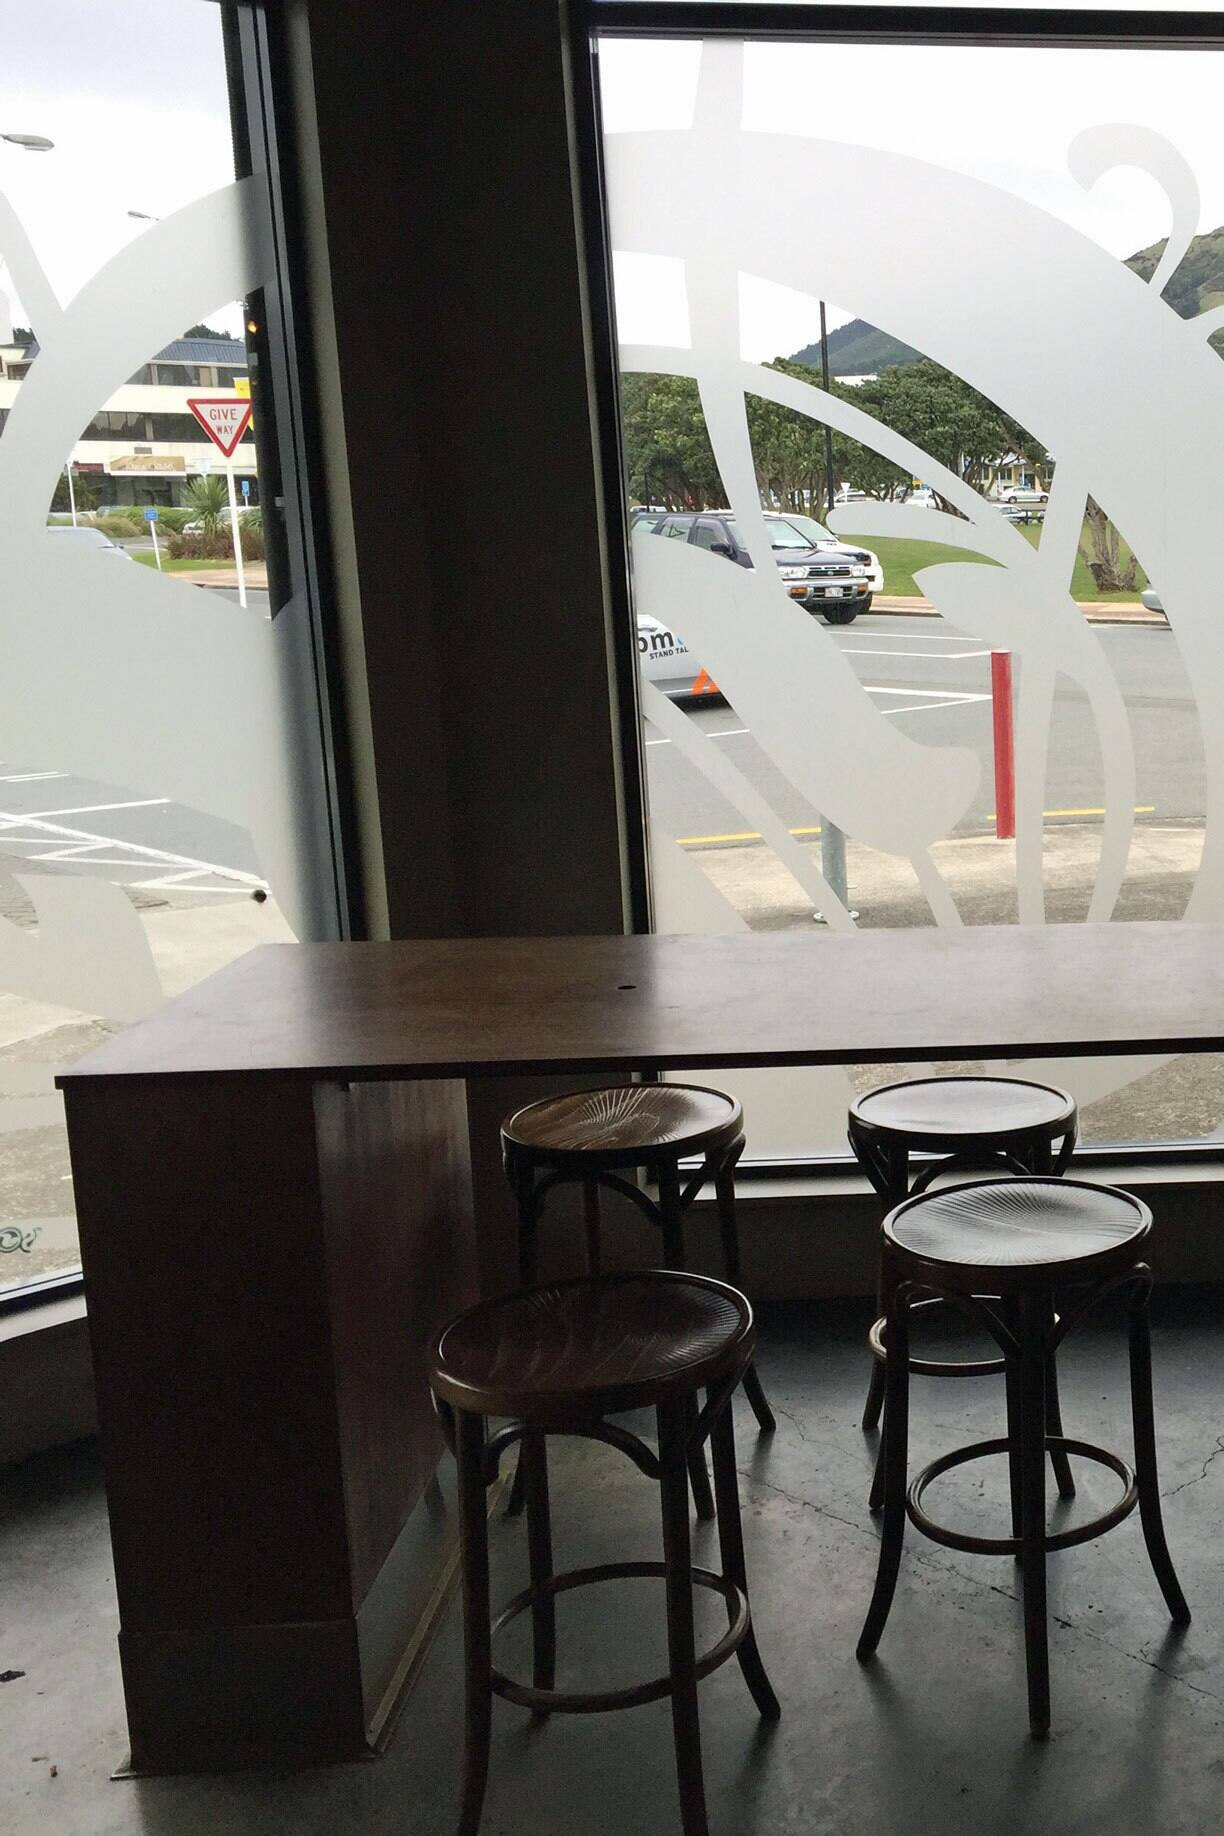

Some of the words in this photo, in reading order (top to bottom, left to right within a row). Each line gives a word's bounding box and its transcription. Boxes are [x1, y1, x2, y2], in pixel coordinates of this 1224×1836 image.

[209, 408, 238, 421] GIVE
[215, 424, 234, 435] WAY
[649, 649, 674, 660] STAND
